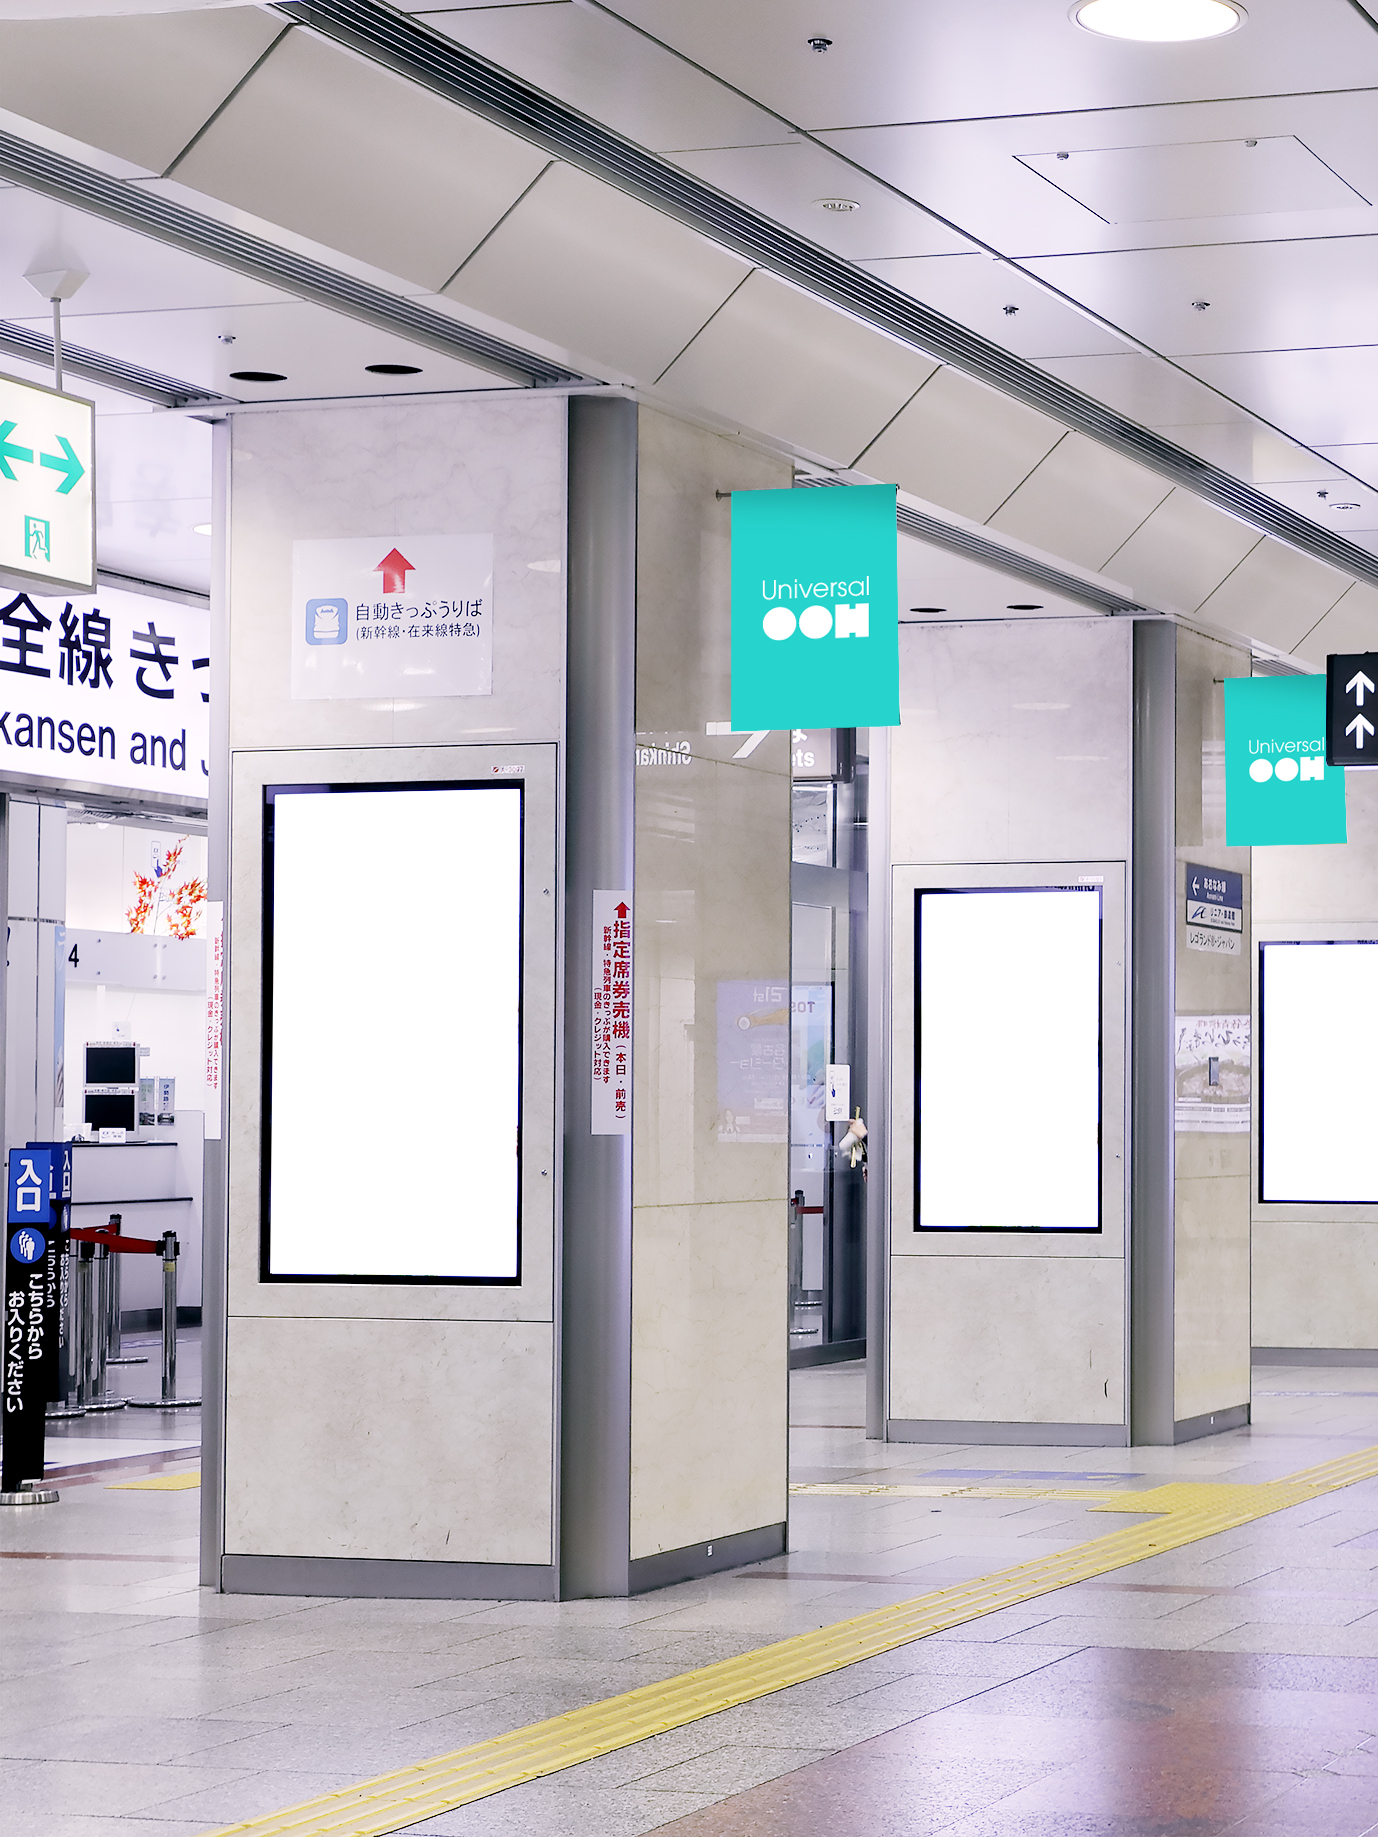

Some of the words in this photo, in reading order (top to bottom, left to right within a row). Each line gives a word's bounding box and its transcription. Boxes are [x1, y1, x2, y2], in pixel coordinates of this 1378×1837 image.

[763, 576, 870, 601] Universal
[356, 599, 483, 621] 自動きっぷうりば
[762, 603, 870, 641] OOH
[130, 728, 186, 771] and
[1249, 736, 1325, 755] Universal
[1249, 756, 1325, 783] OOH
[68, 943, 80, 968] 4
[15, 1158, 43, 1214] 入口
[26, 1272, 45, 1360] こちらから
[6, 1290, 26, 1413] お入りください
